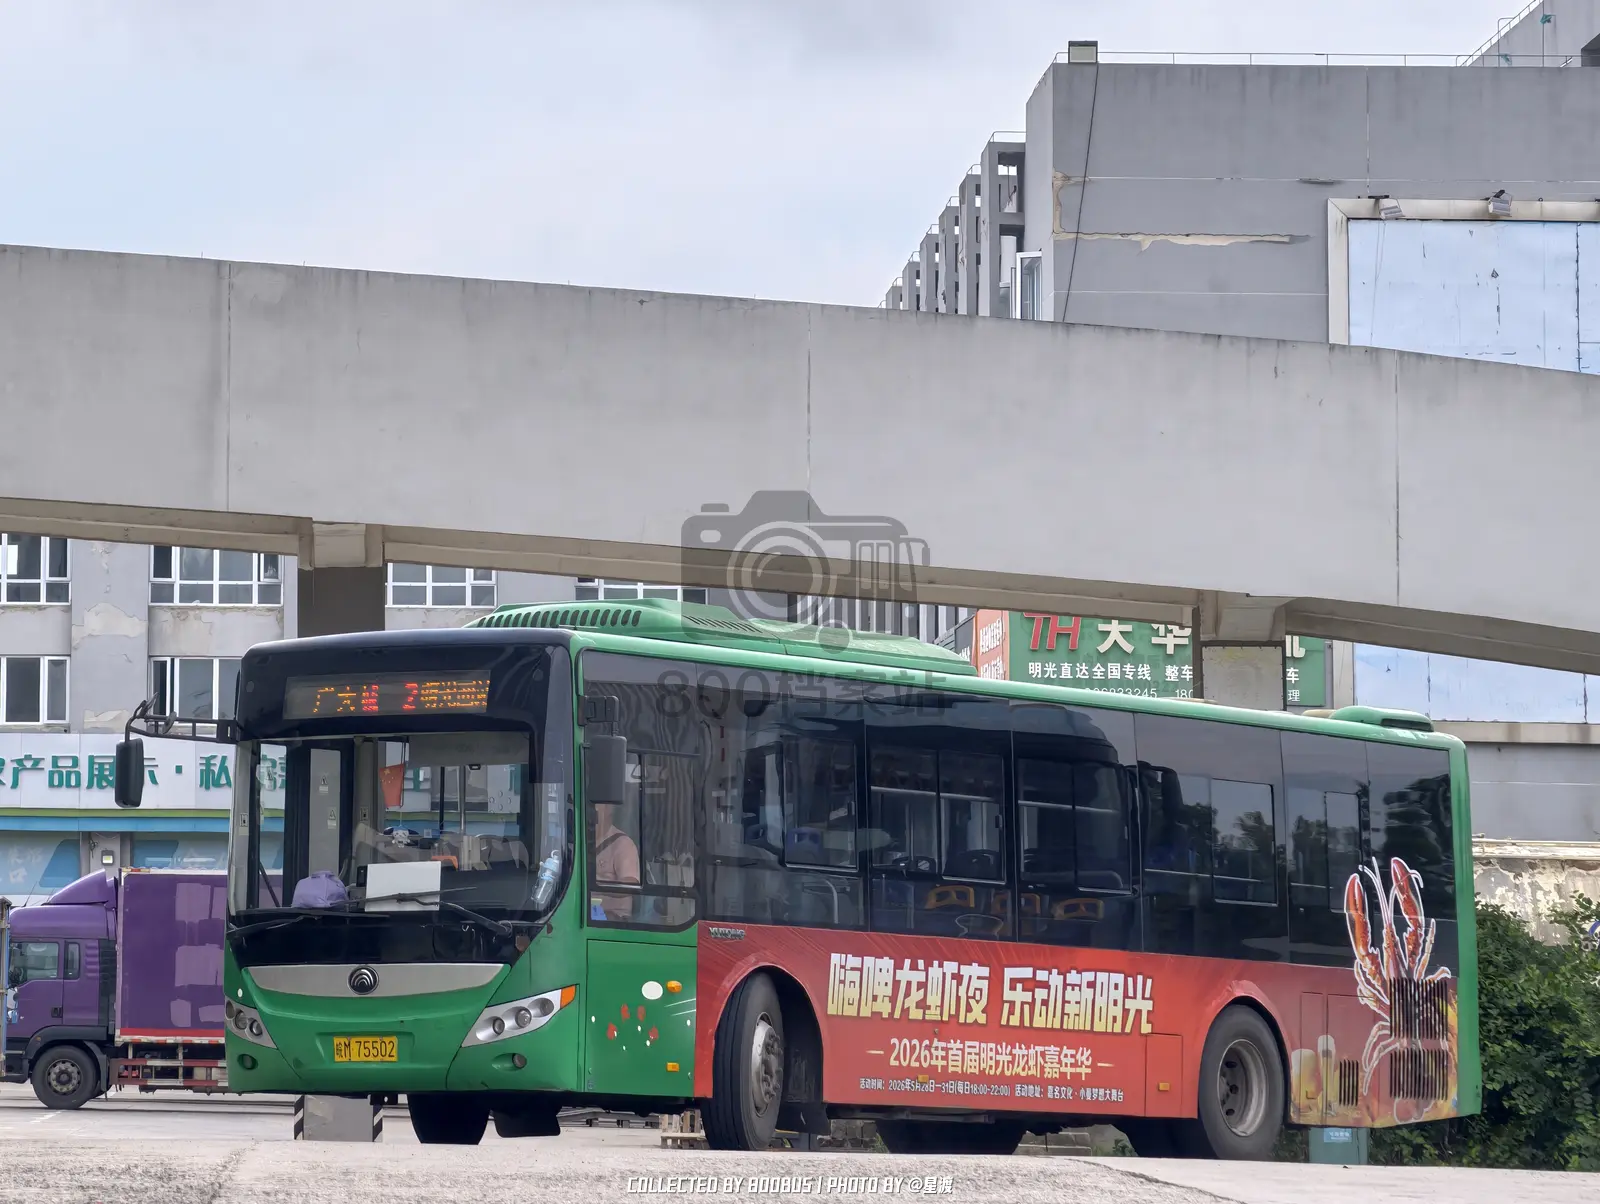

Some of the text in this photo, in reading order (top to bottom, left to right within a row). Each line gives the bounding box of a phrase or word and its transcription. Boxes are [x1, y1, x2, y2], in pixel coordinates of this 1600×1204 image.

[1028, 661, 1152, 681] 明光直达全国专线
[1164, 664, 1193, 682] 整车
[827, 953, 1153, 1034] 嗨啤龙虾夜 乐动新明光
[889, 1038, 1092, 1081] 2026年首届明光龙虾嘉年华
